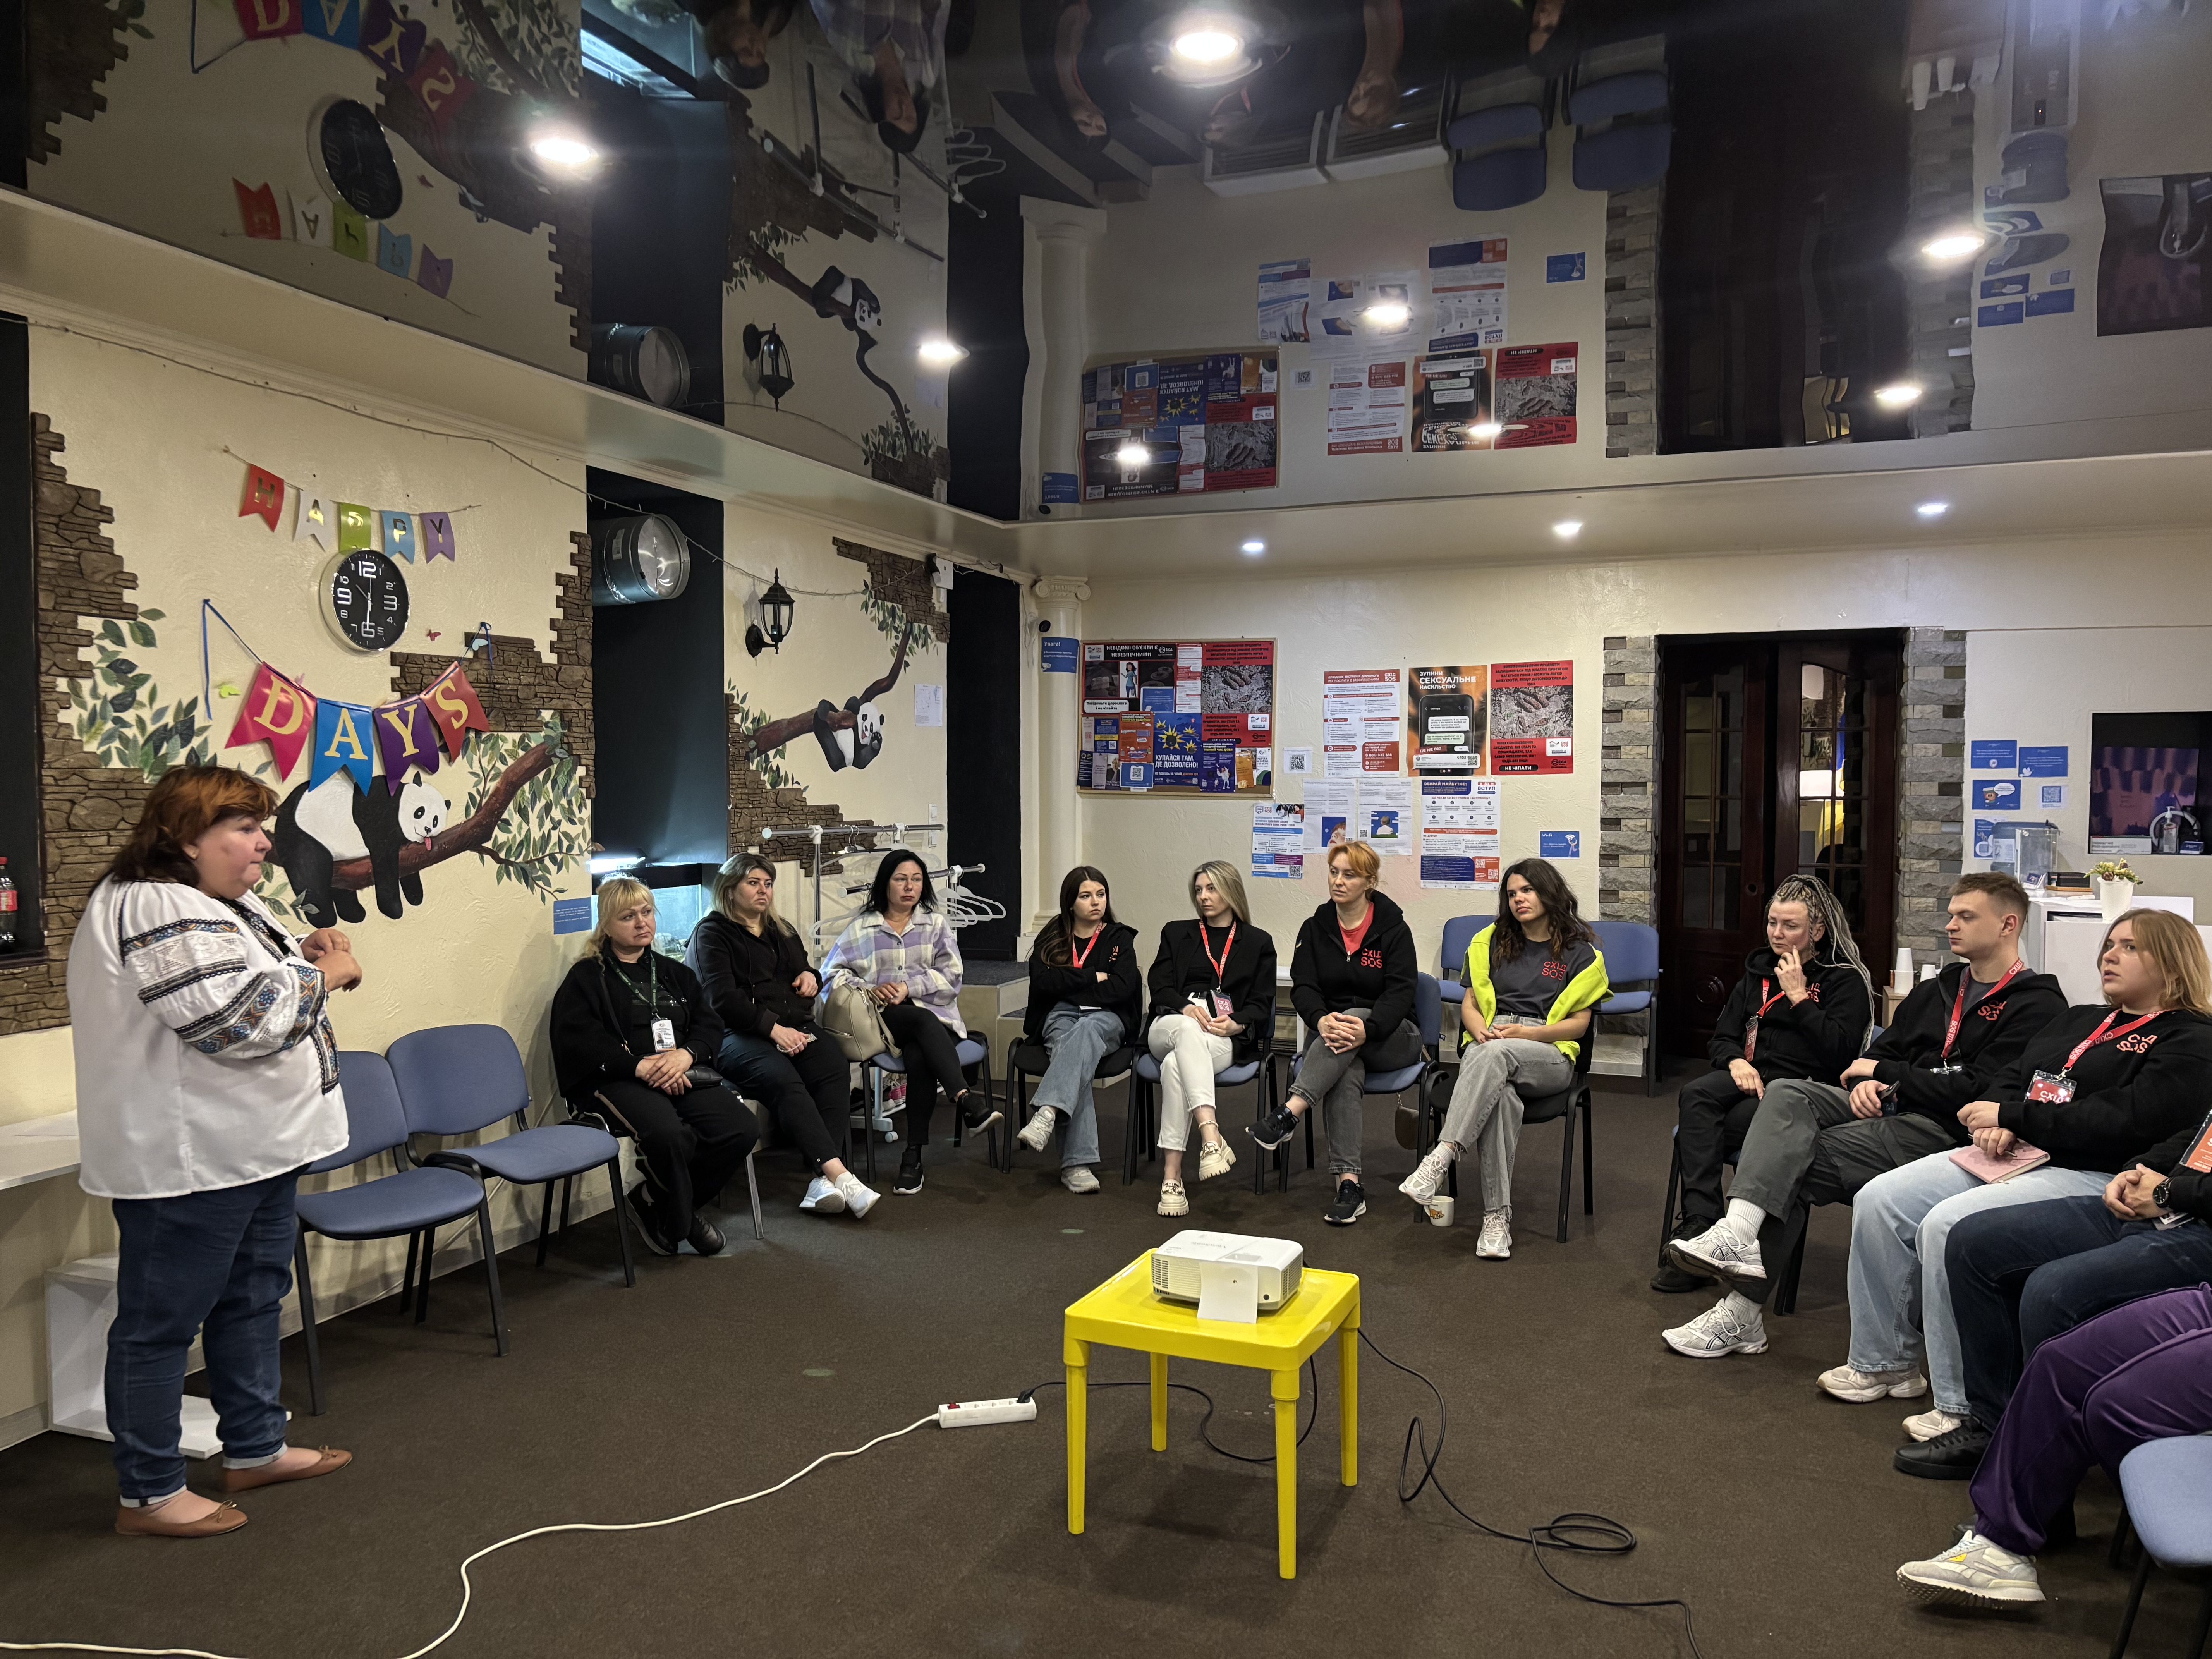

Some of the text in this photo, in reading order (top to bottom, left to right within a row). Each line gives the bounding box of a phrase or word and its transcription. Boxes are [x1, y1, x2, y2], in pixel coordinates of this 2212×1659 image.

[358, 560, 377, 579] 12
[340, 575, 349, 584] 10
[386, 582, 393, 590] 2
[337, 587, 352, 605] 9
[383, 595, 397, 611] 3
[340, 610, 348, 618] 8
[350, 623, 357, 632] 7
[361, 621, 375, 638] 6
[377, 627, 384, 635] 5
[1419, 676, 1476, 684] СЕКСУАЛЬНЕ
[252, 675, 469, 761] DAYS
[1362, 948, 1382, 958] СХІД
[1360, 957, 1382, 969] SOS
[1544, 961, 1566, 972] СХІД
[1542, 967, 1563, 980] SOS
[1945, 1032, 1954, 1044] ХІД
